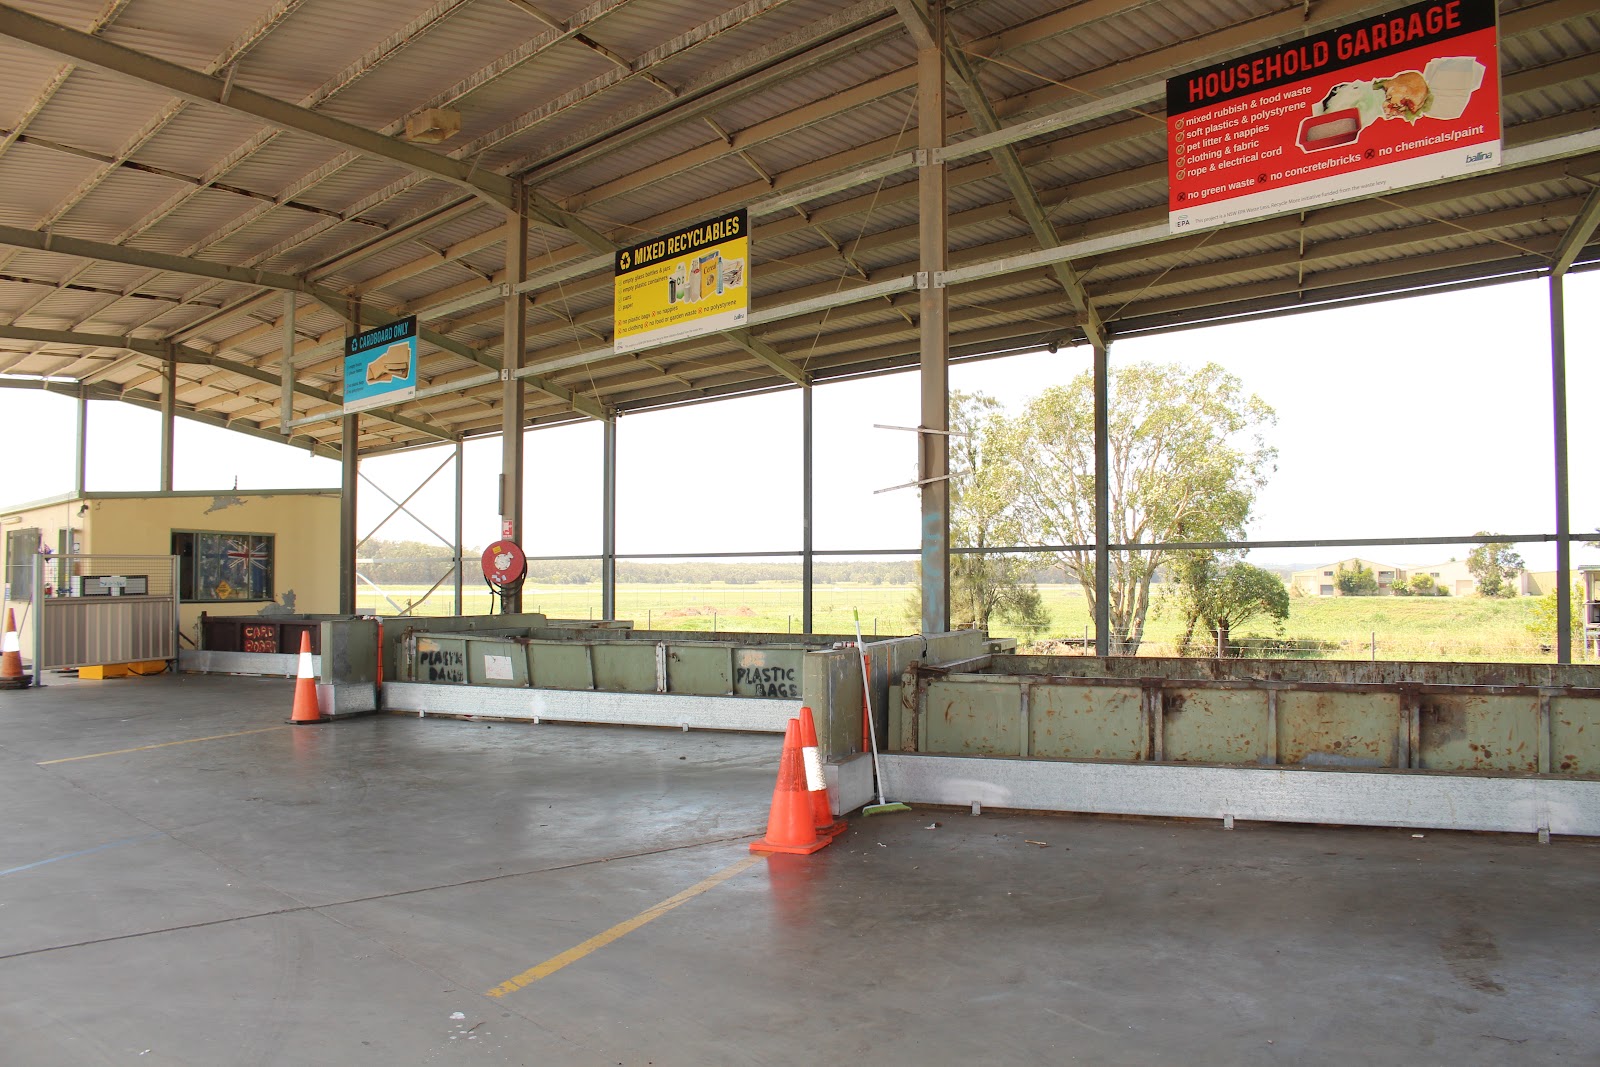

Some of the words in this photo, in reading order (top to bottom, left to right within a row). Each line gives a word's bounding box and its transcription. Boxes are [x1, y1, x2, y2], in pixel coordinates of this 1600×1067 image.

[1189, 40, 1329, 103] HOUSEHOLD
[1336, 1, 1461, 60] GARBAGE
[1186, 112, 1212, 127] mixed
[1214, 103, 1248, 119] rubbish
[1250, 100, 1258, 108] &
[1260, 93, 1281, 106] food
[1283, 86, 1312, 100] waste
[1186, 128, 1203, 139] soft
[1205, 118, 1239, 136] plastics
[1241, 115, 1248, 124] &
[1251, 101, 1306, 123] polystyrene
[1187, 141, 1200, 153] pet
[1202, 134, 1222, 148] litter
[1224, 133, 1232, 142] &
[1234, 123, 1270, 140] nappies
[1187, 149, 1222, 164] clothing
[1224, 146, 1232, 154] &
[1233, 139, 1260, 152] fabric
[1378, 145, 1392, 157] no
[1396, 125, 1484, 153] chemicals/paint
[1187, 165, 1207, 178] rope
[1209, 163, 1216, 172] &
[1218, 154, 1258, 170] electrical
[1261, 146, 1282, 159] cord
[1270, 172, 1282, 180] no
[1285, 152, 1361, 177] concrete/bricks
[1466, 152, 1492, 164] ballina
[1188, 192, 1199, 200] no
[1202, 184, 1226, 198] green
[1228, 178, 1255, 190] waste
[634, 240, 665, 266] MIXED
[668, 216, 740, 255] RECYCLABLES
[360, 327, 392, 348] CARDBOARD
[394, 322, 408, 338] ONLY
[737, 666, 794, 684] PLASTIC
[756, 683, 798, 697] BAGS
